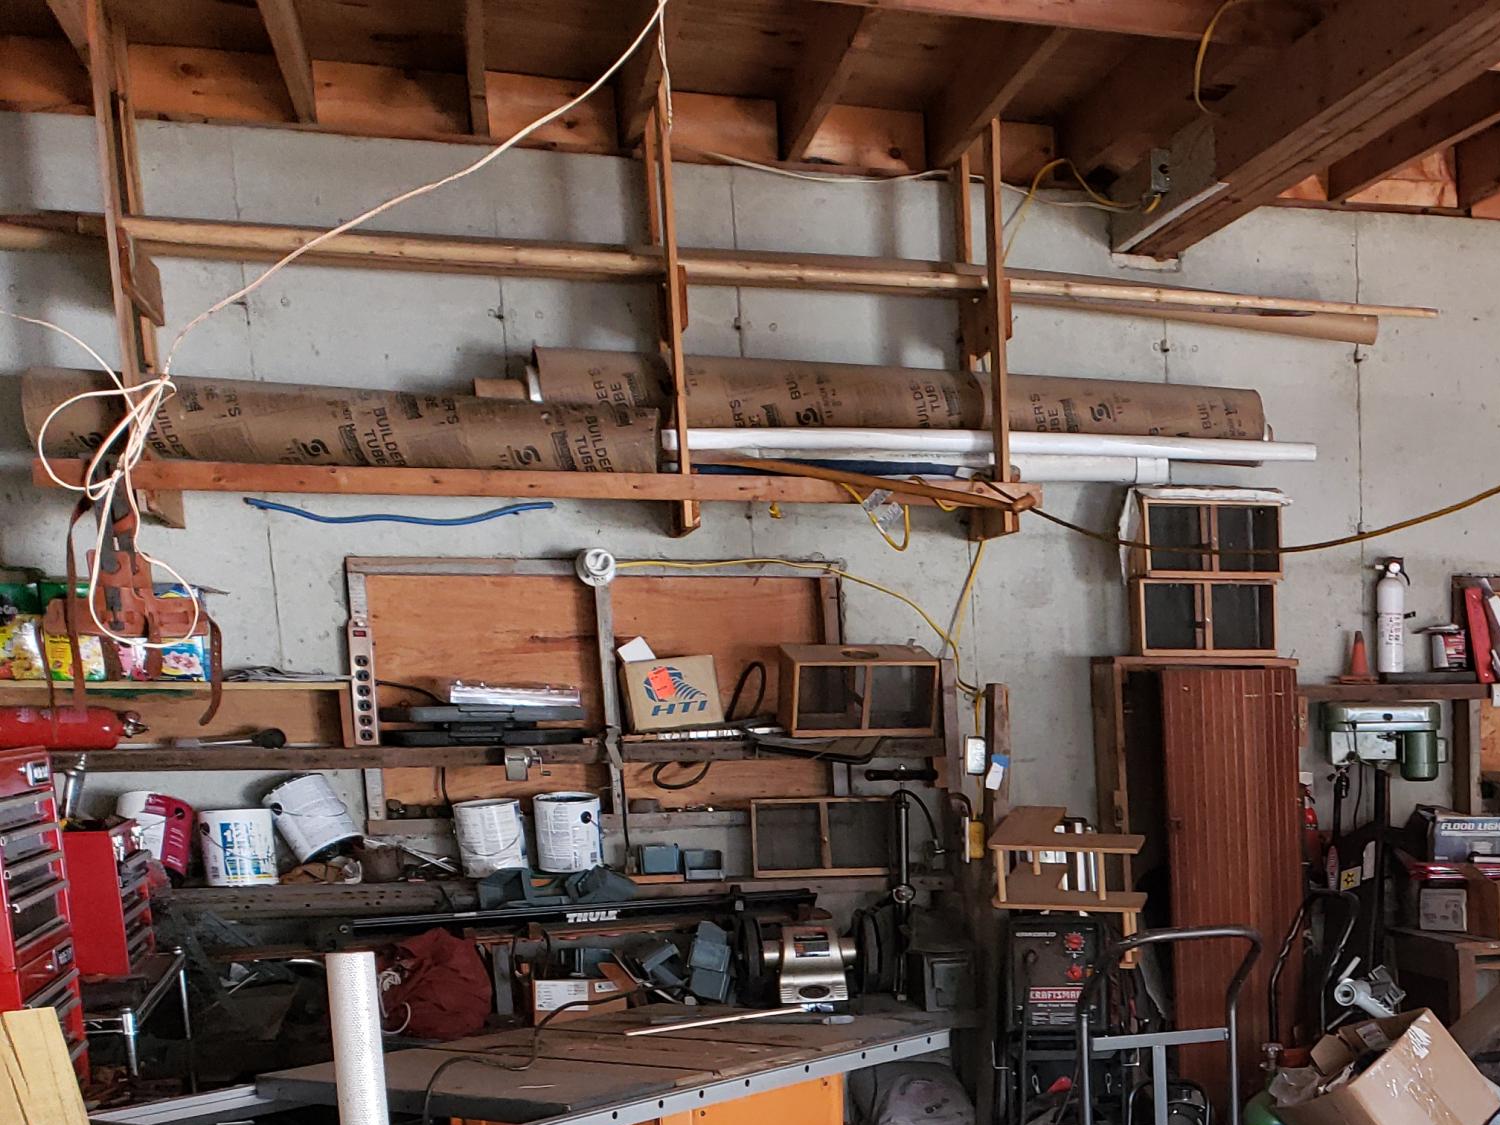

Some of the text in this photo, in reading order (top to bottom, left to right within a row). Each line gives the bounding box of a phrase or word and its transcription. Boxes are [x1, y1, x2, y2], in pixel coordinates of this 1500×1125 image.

[651, 700, 708, 716] HTI
[1441, 822, 1476, 831] FLOOD
[566, 910, 619, 923] THULE
